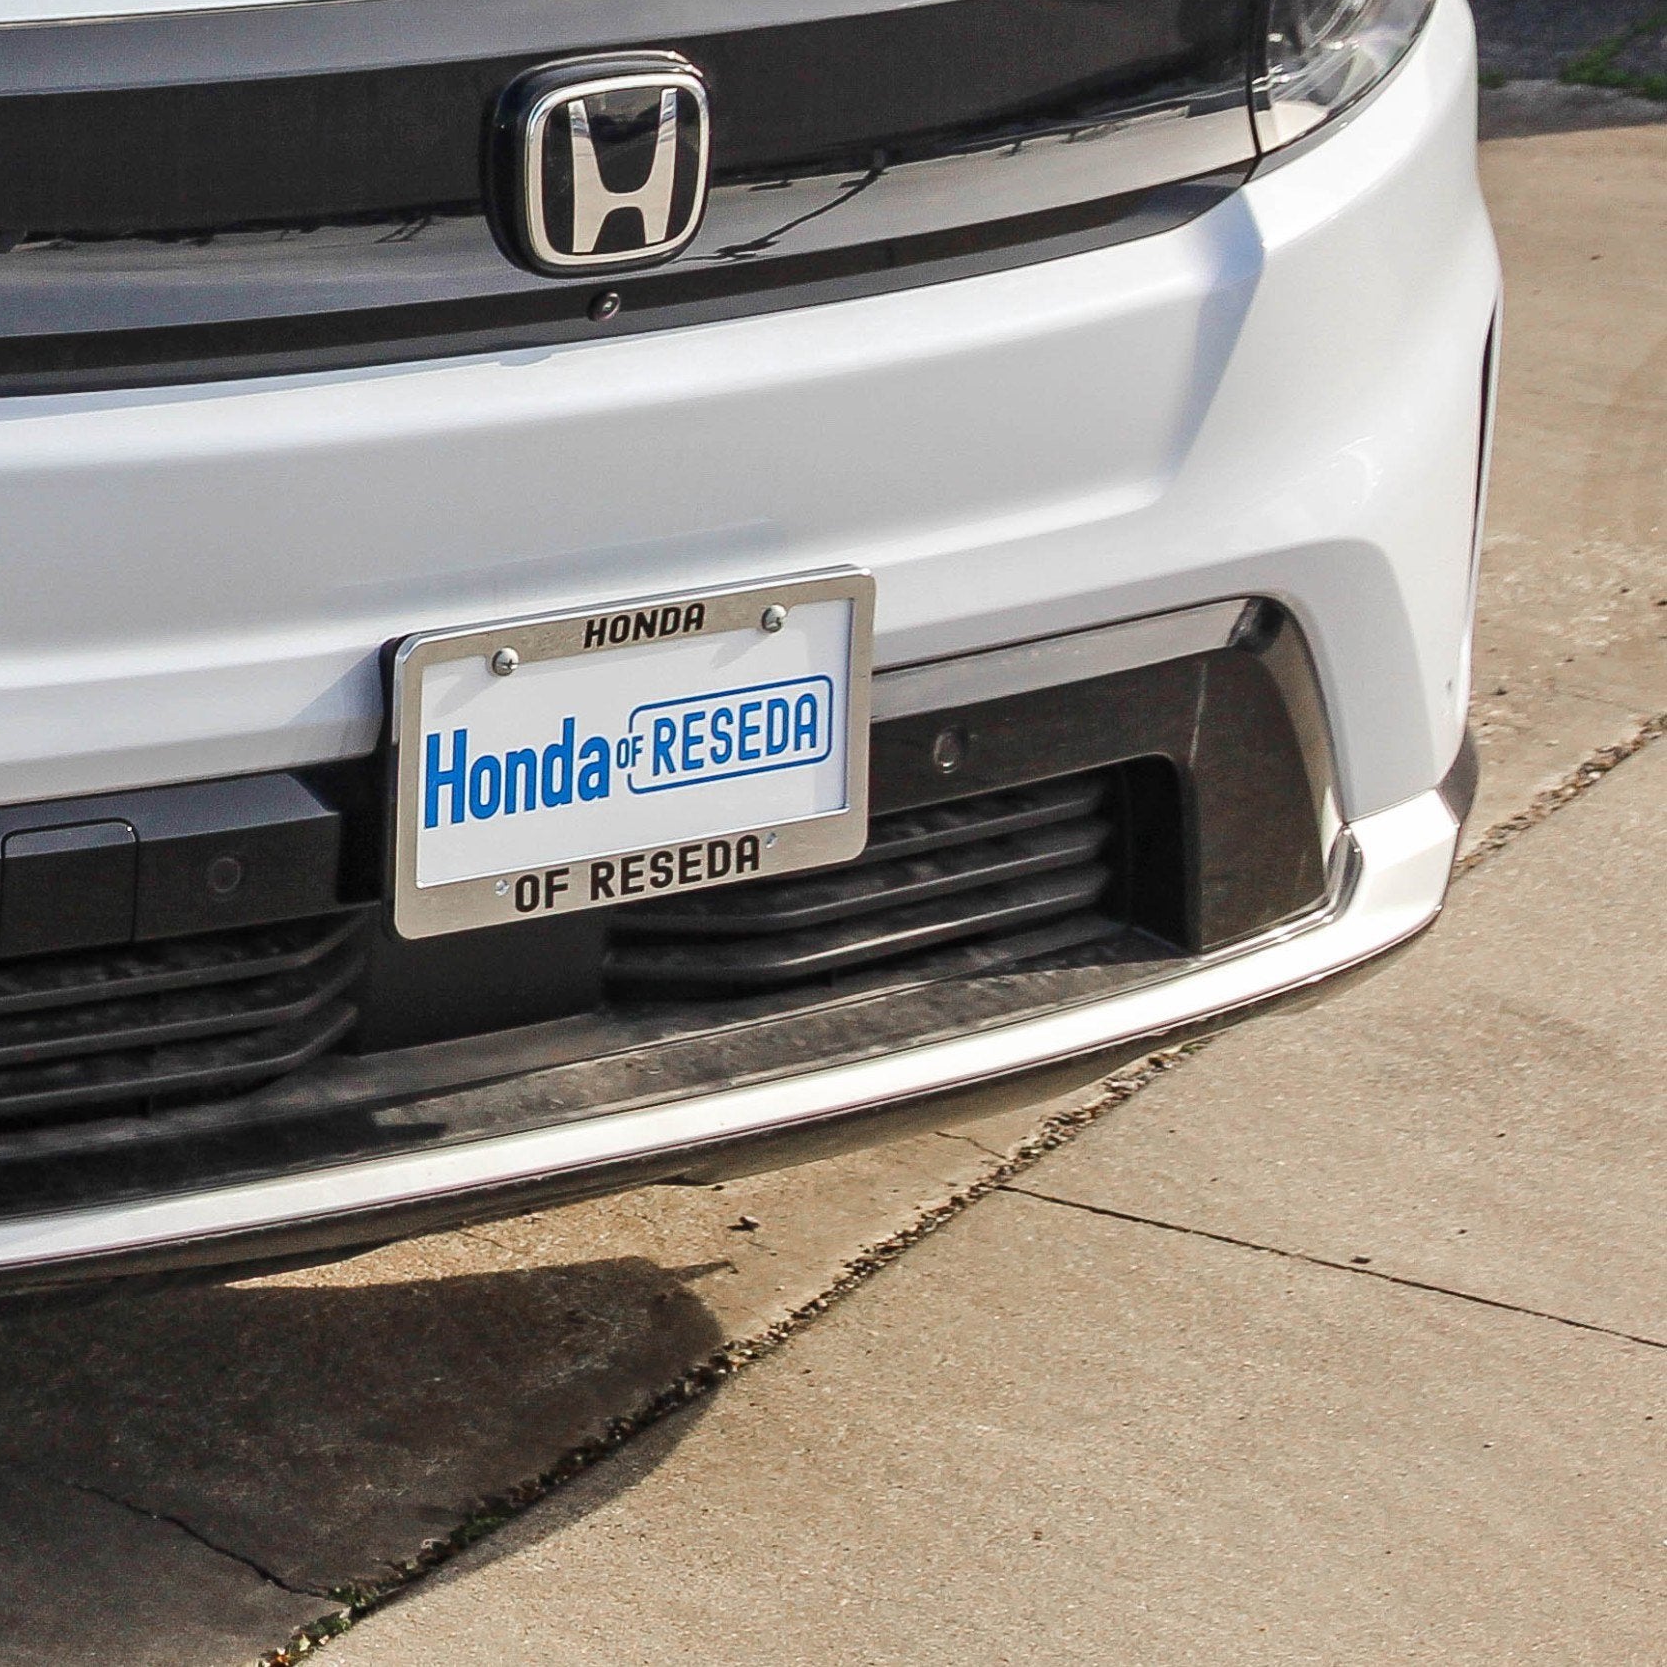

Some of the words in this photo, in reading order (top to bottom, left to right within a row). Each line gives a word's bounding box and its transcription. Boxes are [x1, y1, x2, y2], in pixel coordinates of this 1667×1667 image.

[583, 603, 706, 649] HONDA
[424, 718, 611, 829] Honda
[616, 734, 643, 770] OF
[652, 693, 818, 776] RESEDA
[514, 867, 569, 913] OF
[589, 834, 761, 901] RESEDA
